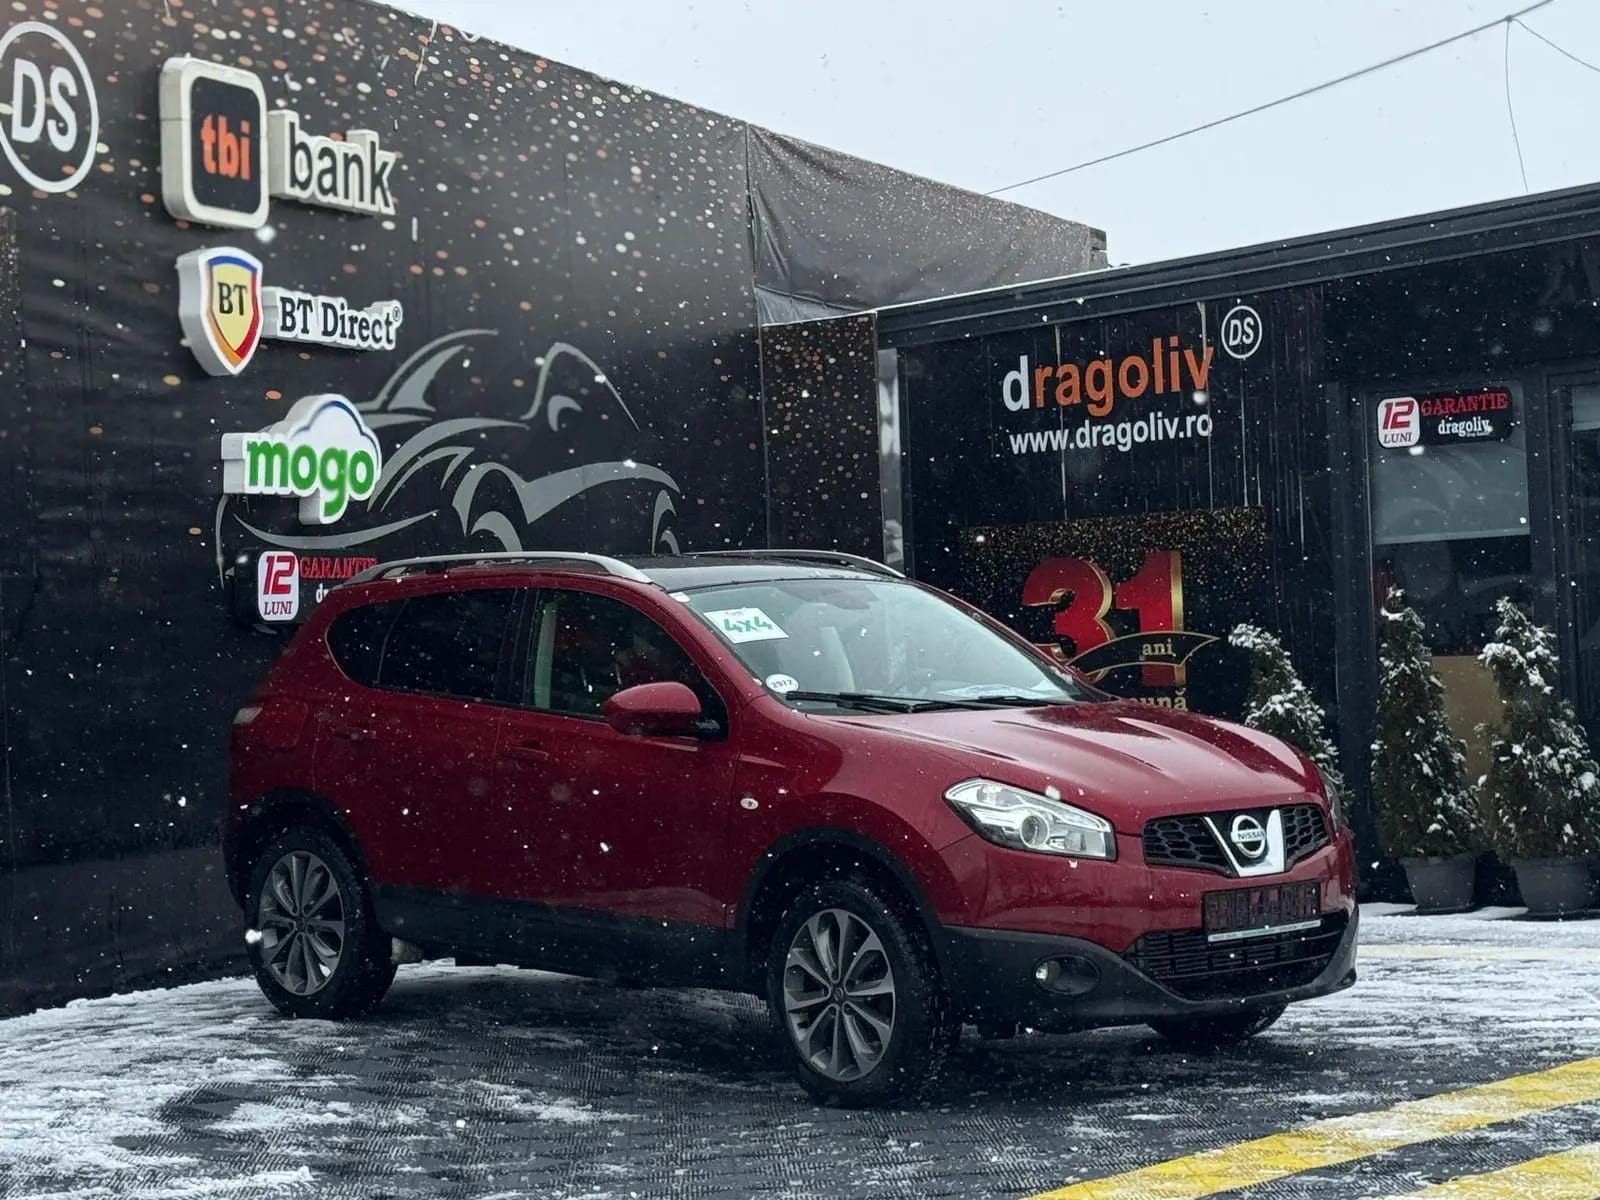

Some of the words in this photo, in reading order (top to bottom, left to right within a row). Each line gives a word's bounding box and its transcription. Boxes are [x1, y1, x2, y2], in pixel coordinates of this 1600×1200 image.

[12, 58, 78, 153] DS
[201, 113, 251, 181] tbi
[290, 122, 391, 206] bank
[218, 282, 248, 316] BT
[280, 296, 313, 334] BT
[1229, 317, 1255, 347] DS
[1002, 335, 1214, 417] dragoliv
[1382, 400, 1415, 430] 12
[1420, 392, 1509, 417] GARANTIE
[1009, 411, 1214, 455] www.dragoliv.ro
[1383, 432, 1412, 444] LUNI
[1438, 416, 1490, 437] dragoliv
[247, 440, 375, 517] mogo
[263, 555, 296, 595] 12
[263, 600, 293, 616] LUNI
[1020, 550, 1185, 687] 31
[1142, 637, 1174, 656] ani
[1237, 830, 1265, 840] NISSAN
